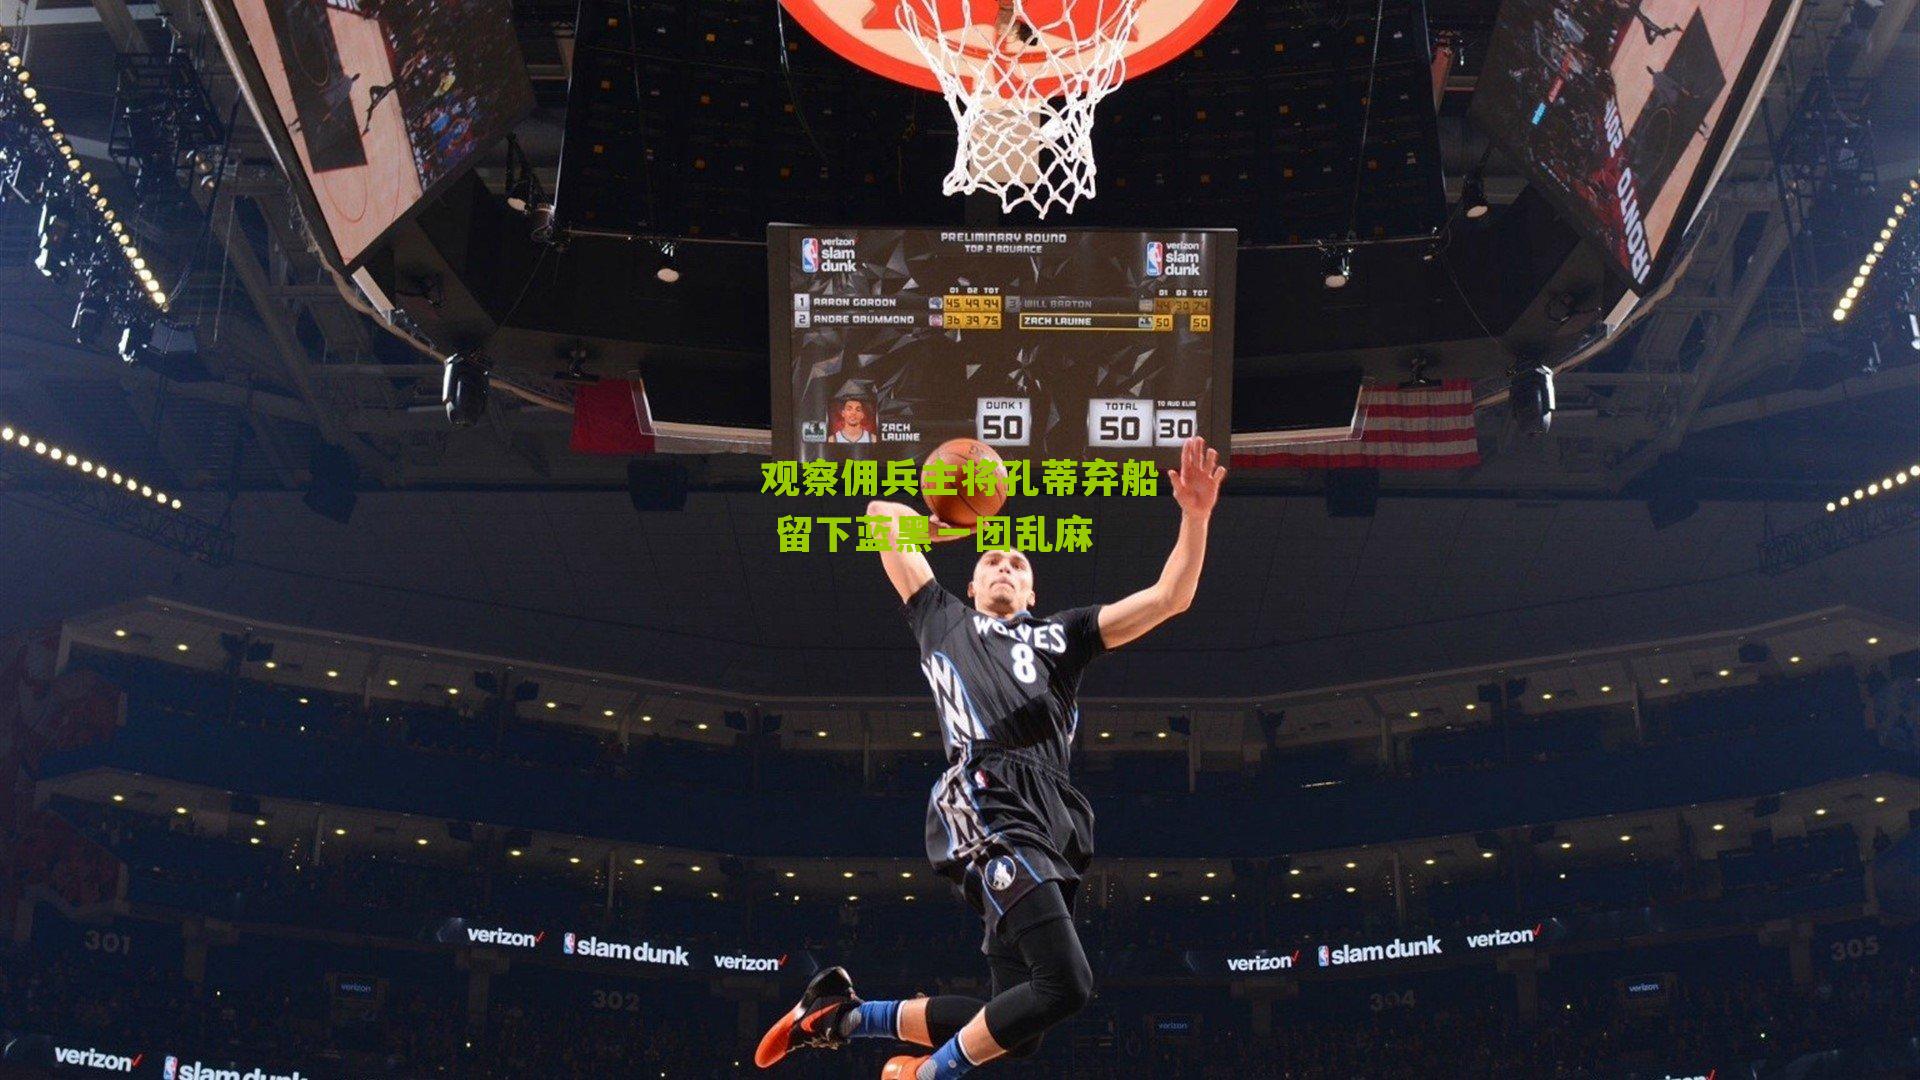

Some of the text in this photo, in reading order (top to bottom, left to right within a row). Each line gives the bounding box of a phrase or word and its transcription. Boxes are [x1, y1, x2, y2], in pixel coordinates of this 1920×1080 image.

[821, 238, 855, 246] verizon
[941, 232, 1067, 243] PRELIMINARY ROUND
[821, 246, 855, 259] slam
[986, 245, 993, 253] 2
[996, 245, 1042, 253] ADVANCE
[1166, 250, 1199, 263] slam
[821, 260, 857, 272] dunk
[1165, 263, 1200, 276] dunk
[813, 298, 850, 306] AARON
[853, 298, 896, 306] GORDON
[946, 299, 959, 308] 45
[965, 299, 979, 308] 49
[984, 299, 999, 308] 94
[1024, 300, 1047, 308] WILL
[1050, 300, 1092, 308] BARTON
[799, 315, 806, 324] 2
[813, 315, 849, 324] ANDRE
[852, 316, 914, 324] DRUMMOND
[966, 316, 979, 325] 39
[984, 316, 998, 325] 75
[1024, 317, 1208, 327] ZACH LAVINE 50 50
[1106, 402, 1138, 410] TOTAL
[882, 423, 910, 432] ZACH
[983, 415, 1022, 439] 50
[1100, 416, 1140, 441] 50
[1160, 419, 1192, 438] 30
[882, 433, 920, 441] LAVINE
[1011, 643, 1037, 684] 8
[85, 929, 131, 954] 301
[467, 926, 535, 948] verizon
[1467, 928, 1533, 948] verizon
[577, 936, 689, 966] slam dunk
[1332, 935, 1442, 965] slam dunk
[1830, 934, 1880, 962] 305
[714, 953, 778, 972] verizon
[1227, 952, 1292, 972] verizon
[54, 1046, 132, 1073] verizon
[178, 1060, 240, 1080] slam
